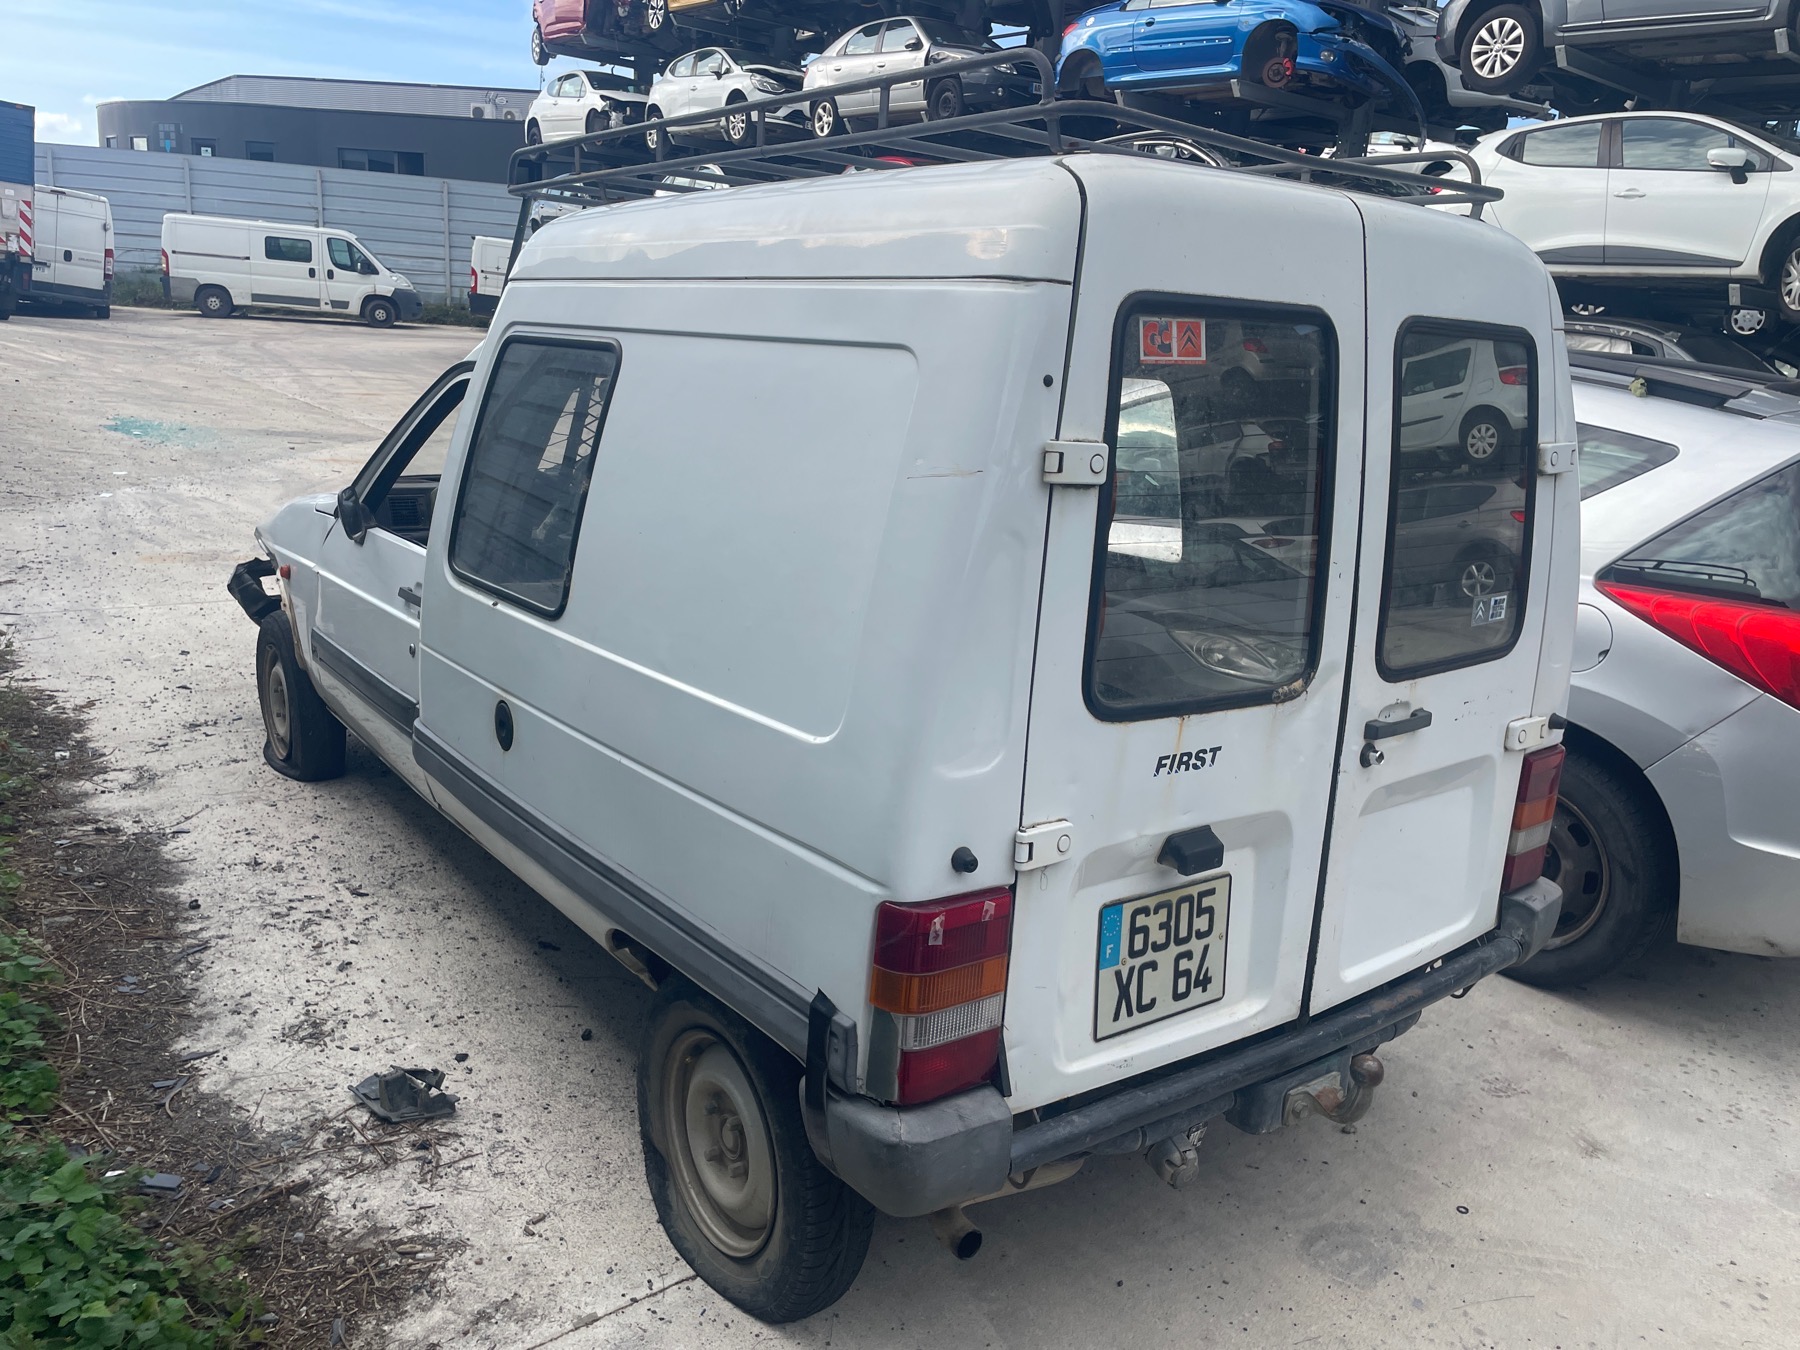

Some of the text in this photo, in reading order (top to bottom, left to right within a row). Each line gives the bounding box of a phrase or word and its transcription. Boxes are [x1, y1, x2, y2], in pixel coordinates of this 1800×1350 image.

[1153, 745, 1222, 777] FIRST
[1128, 887, 1216, 959] 6305
[1106, 944, 1114, 958] F
[1112, 943, 1212, 1022] XC 64
